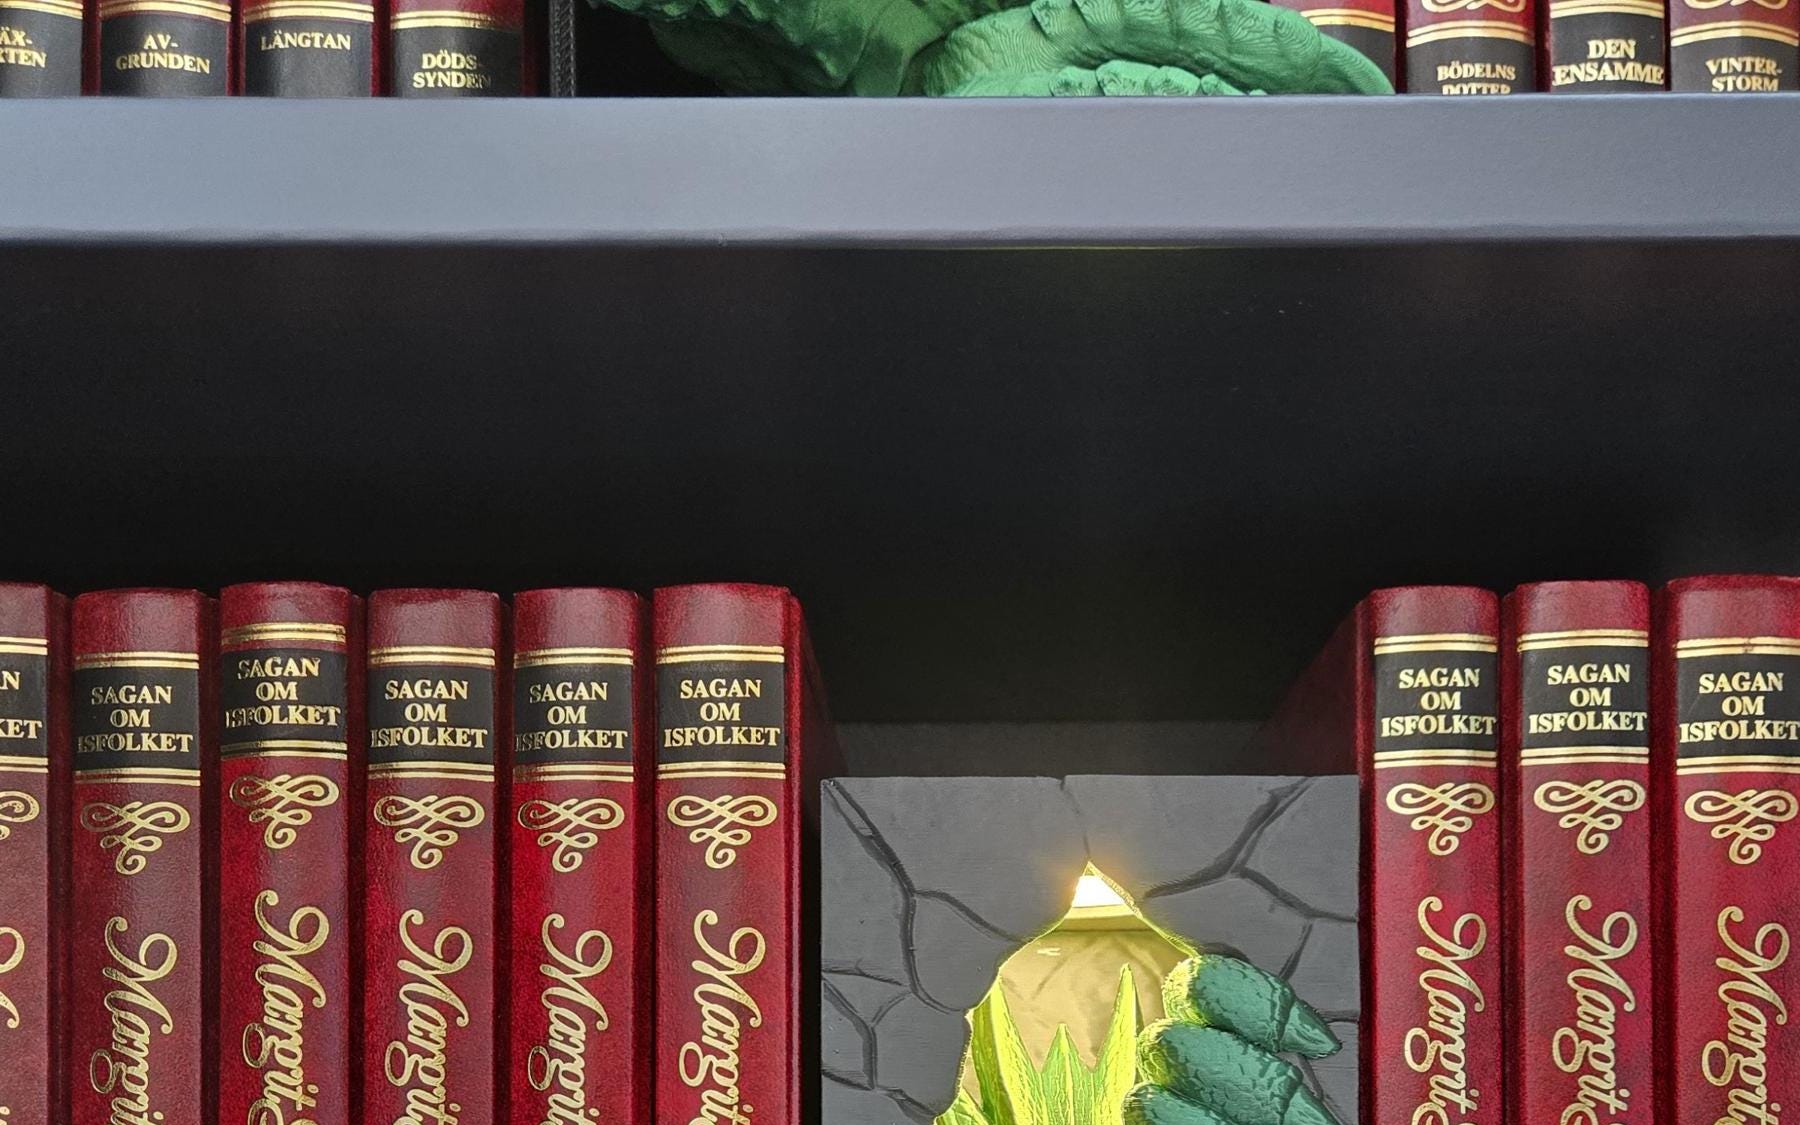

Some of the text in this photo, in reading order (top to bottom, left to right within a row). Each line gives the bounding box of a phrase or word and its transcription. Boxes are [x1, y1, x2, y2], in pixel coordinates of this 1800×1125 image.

[0, 26, 33, 47] ÄX-
[144, 33, 178, 50] AV-
[262, 30, 351, 50] LÄNGTAN
[1587, 39, 1636, 59] DEN
[116, 52, 210, 74] GRUNDEN
[1437, 61, 1515, 81] BÖDELNS
[1552, 61, 1663, 86] ENSAMME
[1706, 57, 1781, 77] VINTER-
[412, 71, 491, 89] SYNDEN
[1712, 75, 1778, 92] STORM
[238, 657, 320, 679] SAGAN
[1399, 668, 1479, 689] SAGAN
[1547, 664, 1630, 685] SAGAN
[256, 681, 298, 701] OM
[385, 680, 468, 700] SAGAN
[530, 682, 608, 703] SAGAN
[680, 679, 761, 699] SAGAN
[1699, 672, 1783, 694] SAGAN
[92, 685, 172, 704] SAGAN
[1420, 691, 1461, 710] OM
[1570, 687, 1611, 707] OM
[226, 705, 341, 727] ISFOLKET
[405, 703, 447, 722] OM
[548, 703, 587, 724] OM
[700, 702, 740, 721] OM
[1722, 696, 1764, 716] OM
[110, 709, 150, 727] OM
[1381, 715, 1496, 737] ISFOLKET
[1528, 711, 1647, 734] ISFOLKET
[372, 726, 488, 748] ISFOLKET
[515, 729, 628, 751] ISFOLKET
[664, 726, 780, 747] ISFOLKET
[1679, 720, 1800, 743] ISFOLKET
[77, 733, 193, 753] ISFOLKET
[242, 889, 330, 1111] Margit
[1404, 896, 1487, 1112] Margit
[1552, 894, 1638, 1111] Margit
